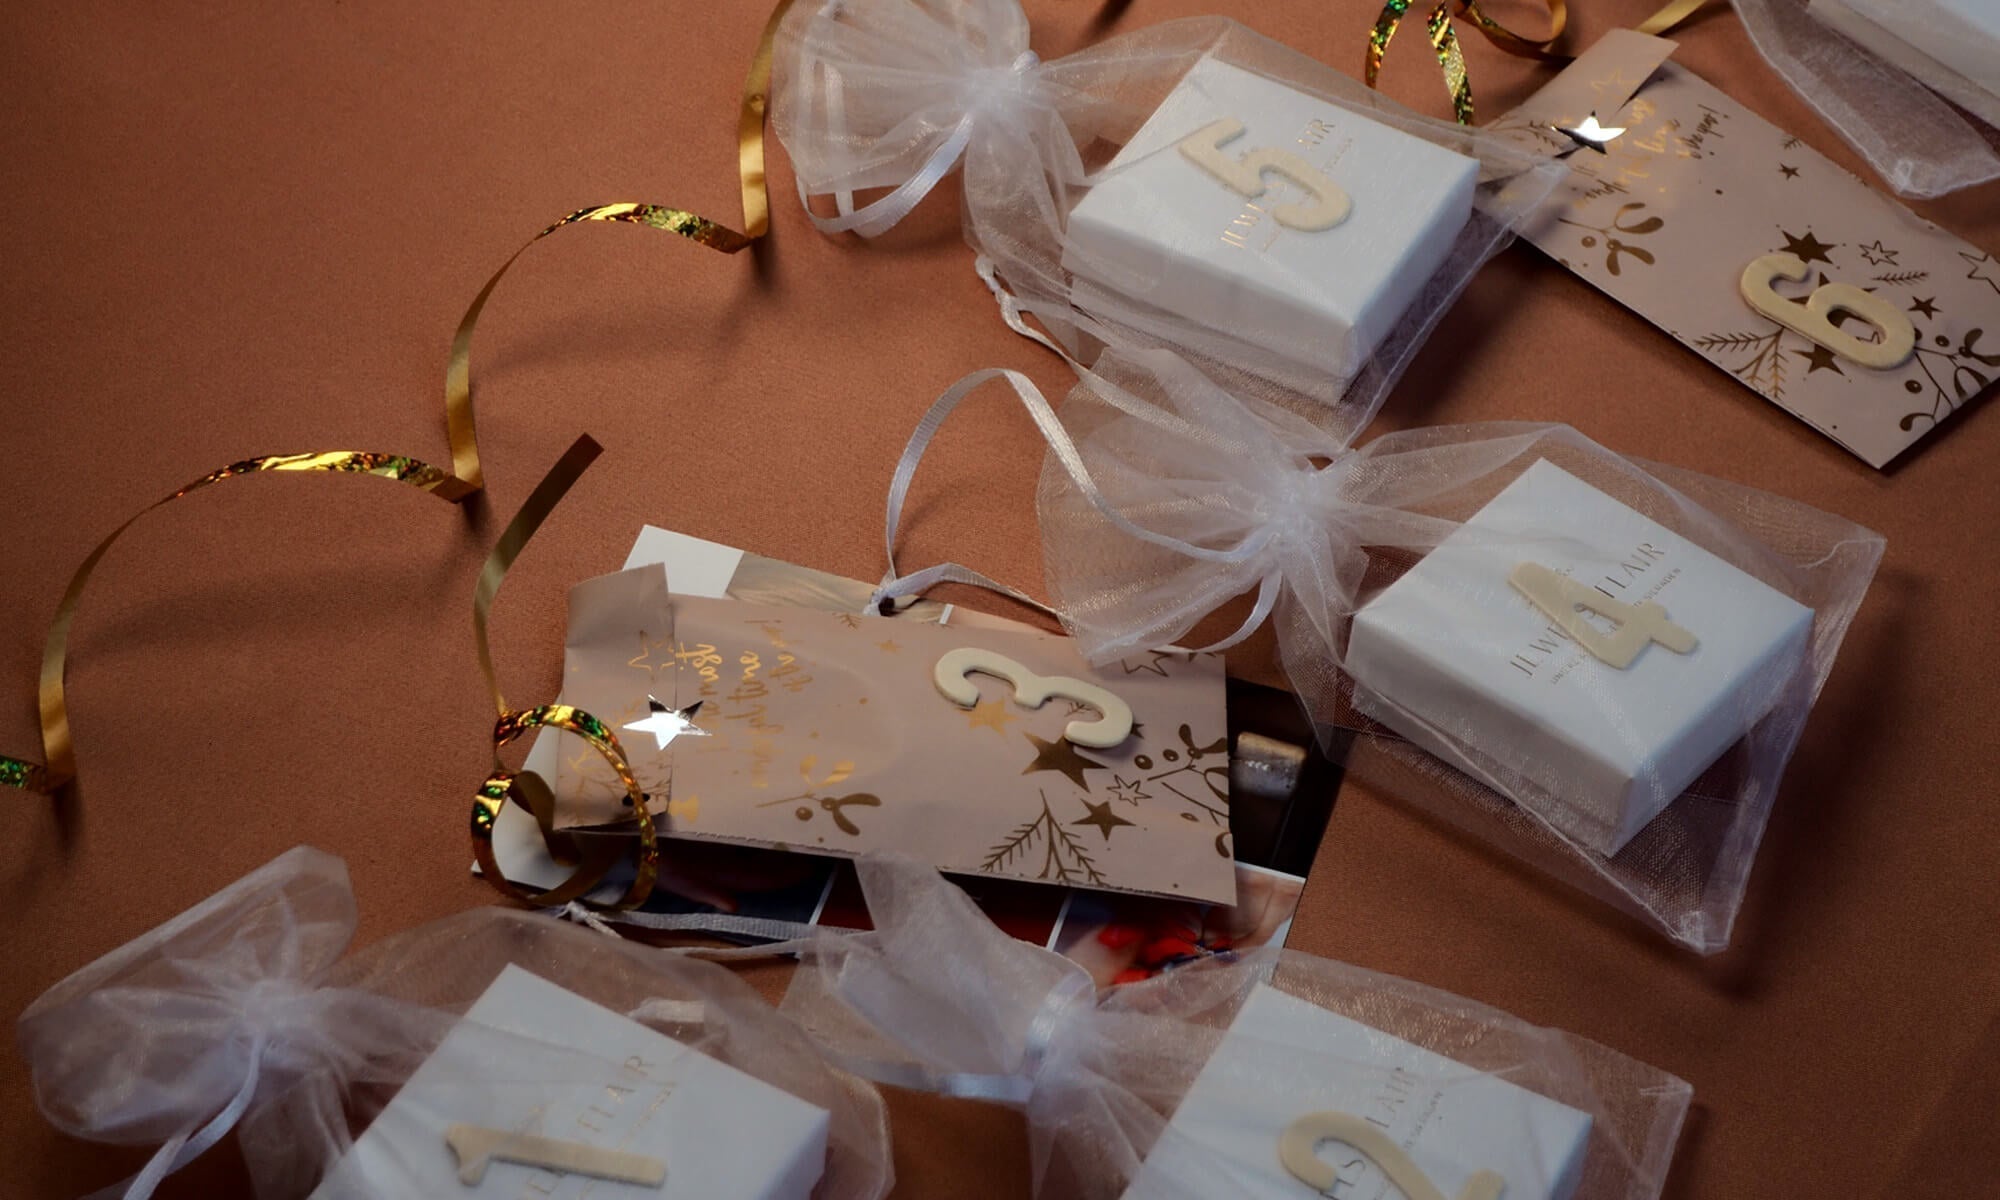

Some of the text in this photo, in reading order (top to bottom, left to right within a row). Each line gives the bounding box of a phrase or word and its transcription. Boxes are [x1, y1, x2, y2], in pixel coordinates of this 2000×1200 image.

[1178, 117, 1354, 232] 5
[1740, 254, 1917, 371] 6
[1594, 543, 1665, 599] FLAIR
[1508, 561, 1700, 670] 4
[675, 641, 723, 696] most
[726, 651, 769, 704] time
[933, 647, 1134, 748] 3
[576, 1055, 656, 1133] FLAR
[445, 1123, 667, 1189] 1
[1279, 1111, 1505, 1200] 2
